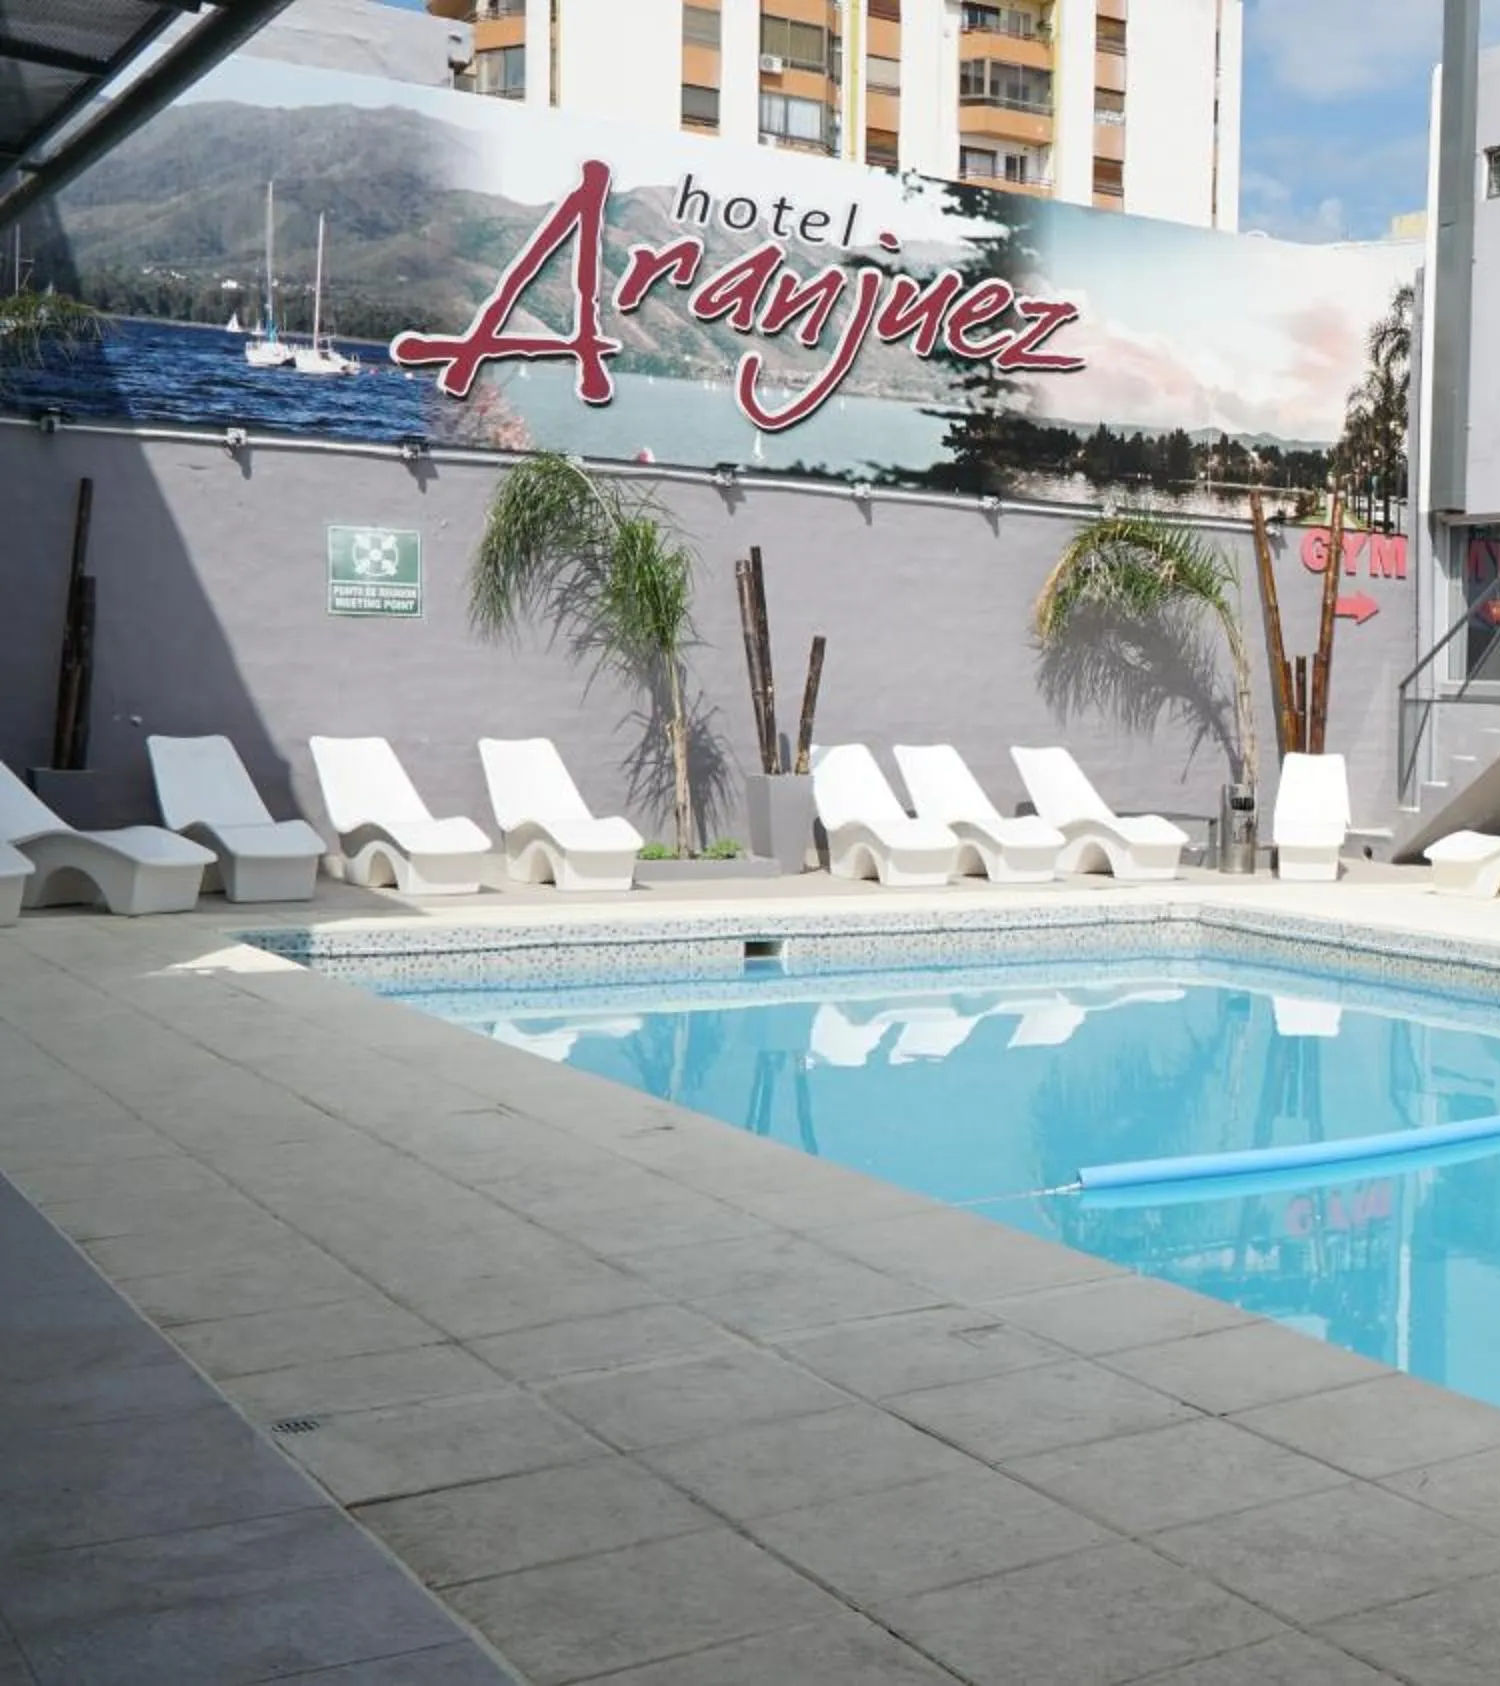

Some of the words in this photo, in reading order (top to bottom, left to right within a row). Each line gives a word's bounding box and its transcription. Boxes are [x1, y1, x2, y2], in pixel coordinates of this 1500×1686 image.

[676, 173, 857, 247] hotel
[391, 158, 1087, 432] Aranjuez
[1300, 527, 1409, 580] GYM
[383, 599, 415, 610] POINT
